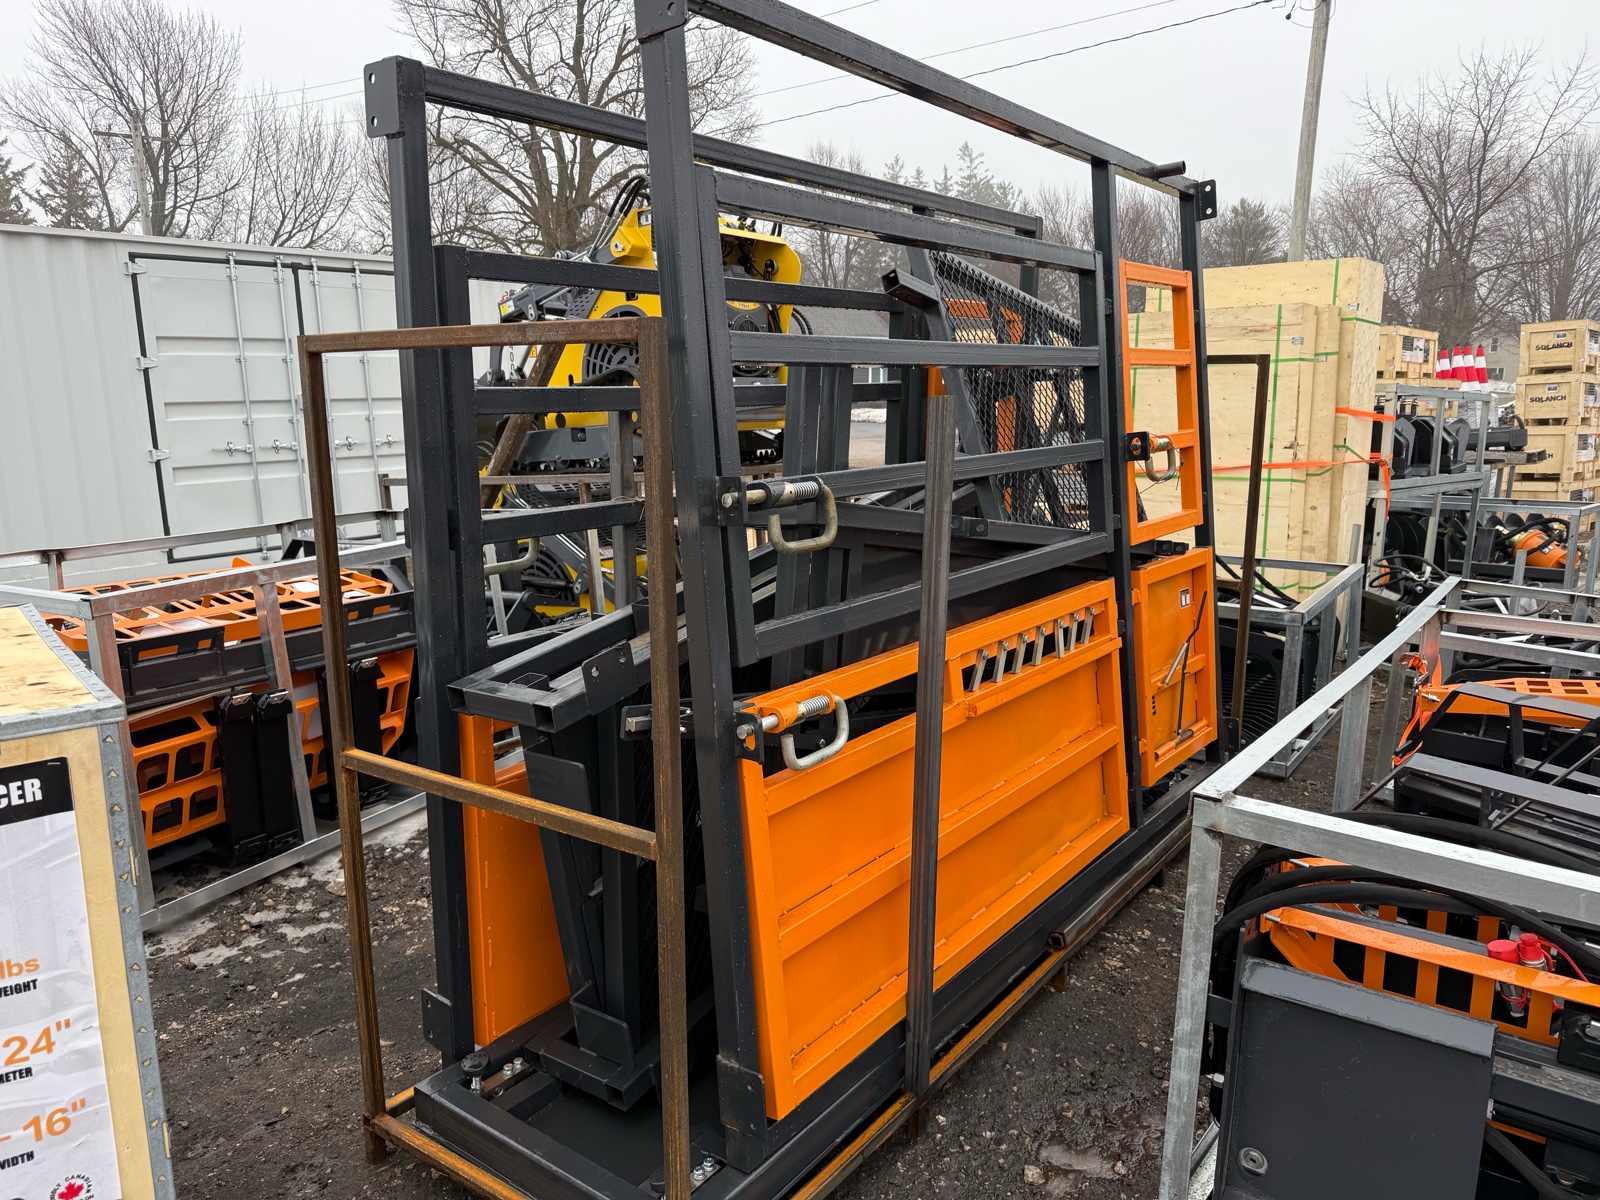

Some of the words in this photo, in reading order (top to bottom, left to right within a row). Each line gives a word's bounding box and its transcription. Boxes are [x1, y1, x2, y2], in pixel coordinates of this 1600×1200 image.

[0, 958, 40, 979] lbs
[2, 1018, 71, 1067] 24"
[22, 1097, 86, 1142] 16"
[65, 1174, 92, 1193] CANADIAN
